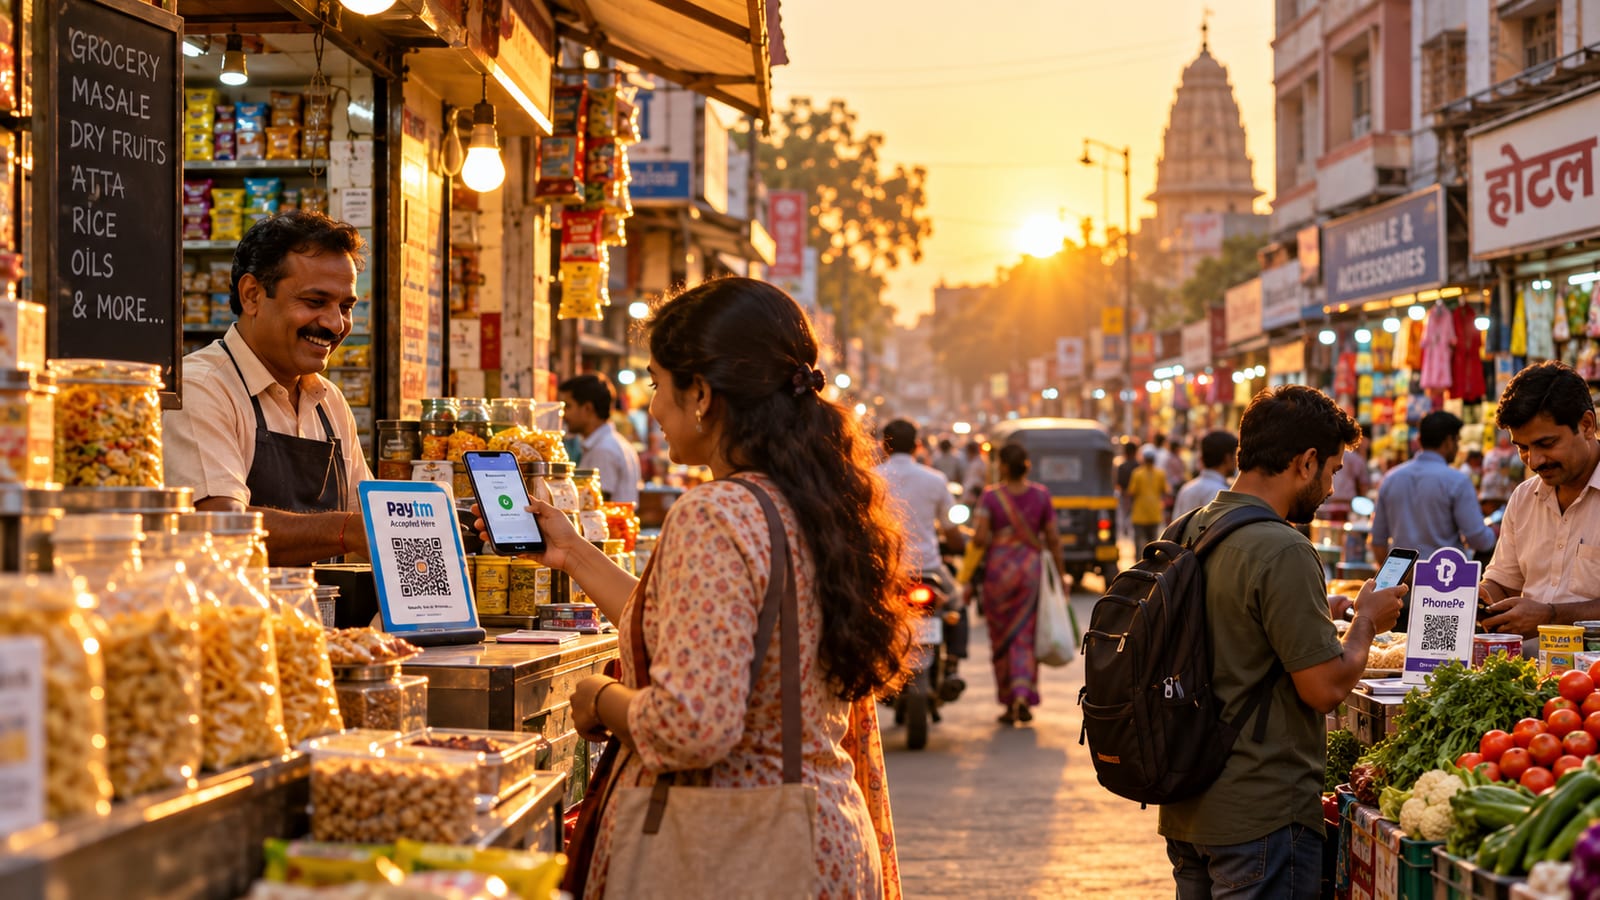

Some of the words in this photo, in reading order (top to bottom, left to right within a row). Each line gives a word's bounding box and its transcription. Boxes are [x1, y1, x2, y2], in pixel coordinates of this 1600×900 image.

[70, 30, 160, 82] GROCERY
[72, 75, 151, 119] MASALE
[70, 120, 106, 153] DRY
[71, 164, 125, 200] ATTA
[1485, 135, 1598, 228] होटल
[72, 201, 117, 238] RICE
[1345, 216, 1399, 259] MOBILE
[1401, 213, 1414, 243] &
[71, 247, 114, 278] OILS
[1336, 246, 1426, 292] ACCESSORIES
[72, 290, 87, 319] &
[97, 293, 164, 325] MORE...
[386, 500, 434, 518] Paytm
[1422, 597, 1465, 609] PhonePe
